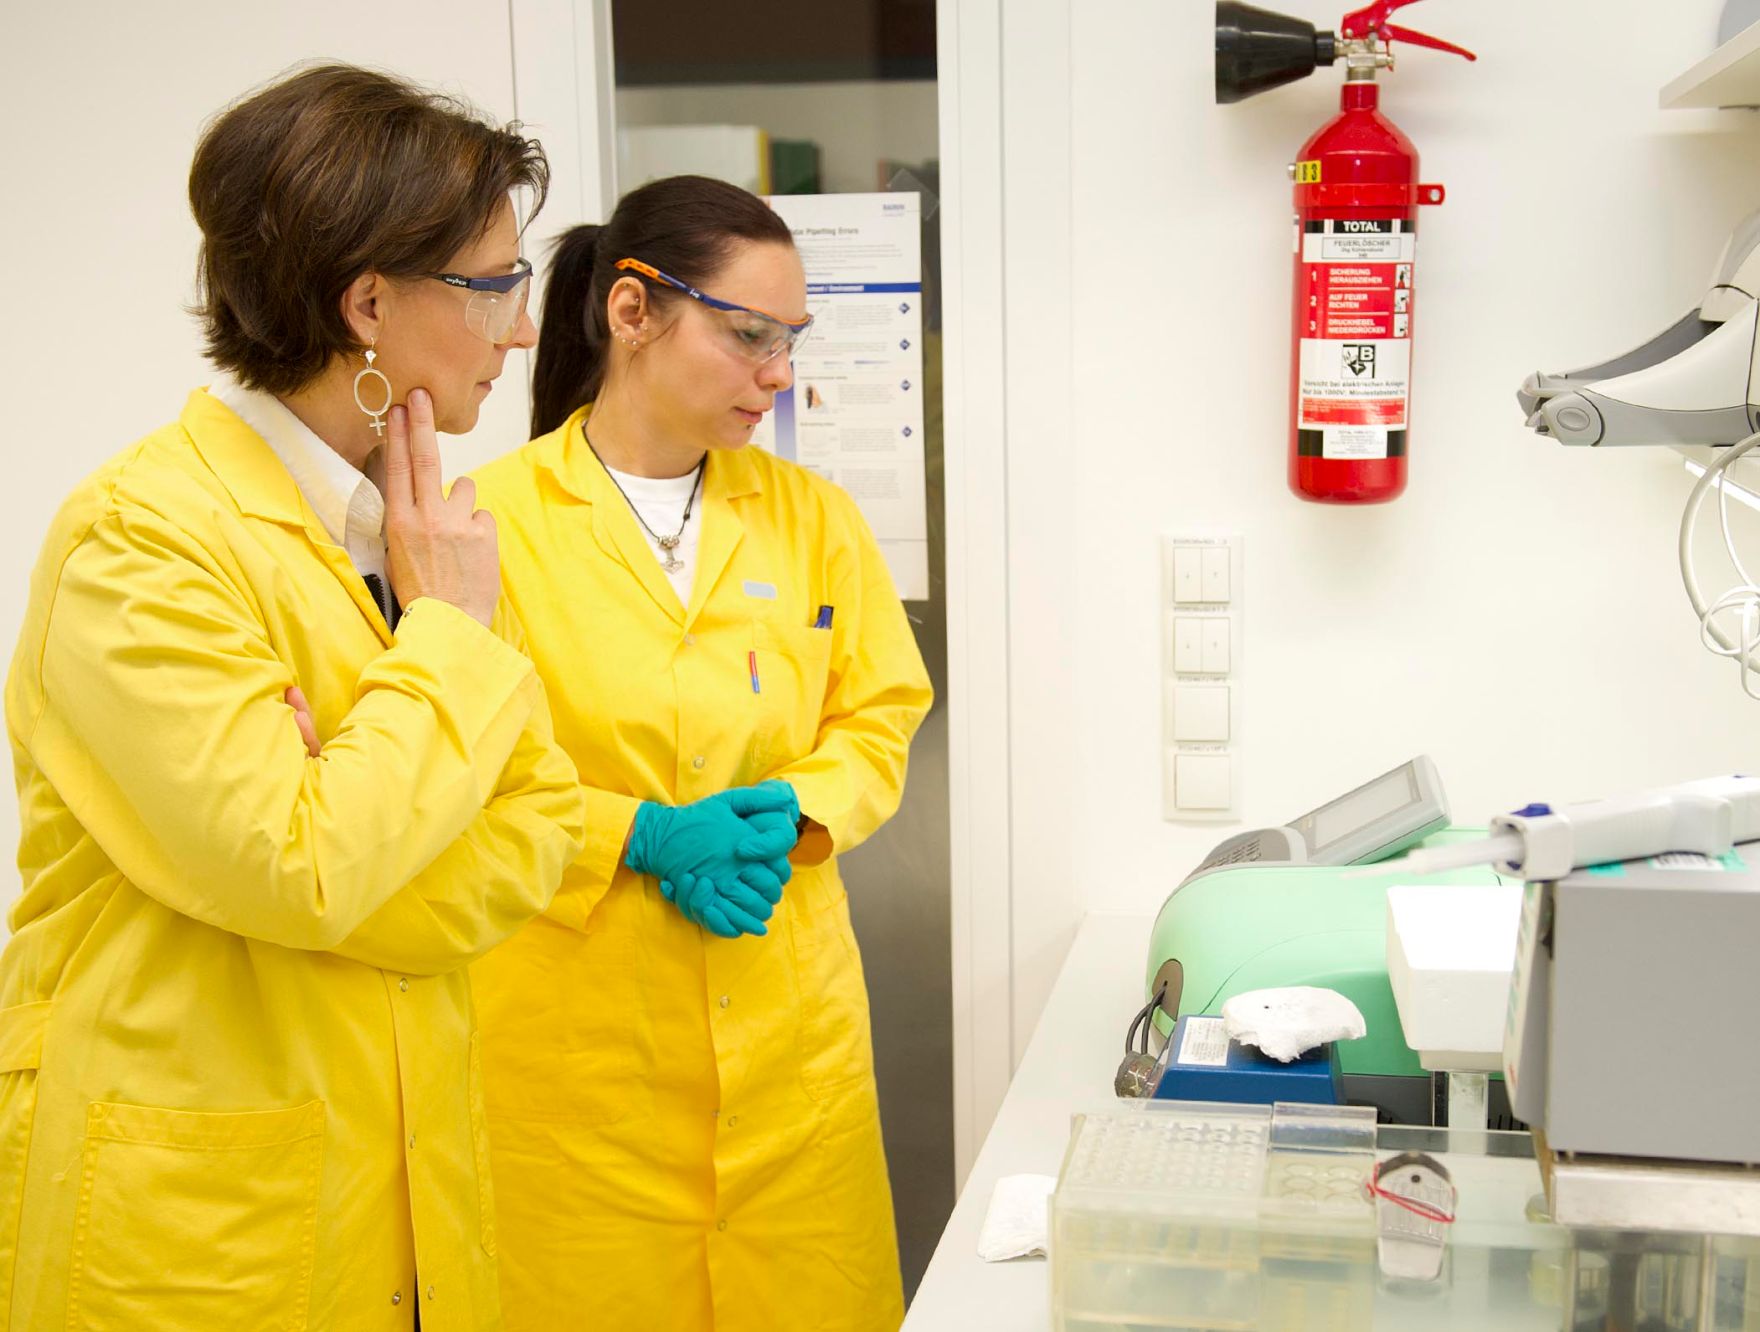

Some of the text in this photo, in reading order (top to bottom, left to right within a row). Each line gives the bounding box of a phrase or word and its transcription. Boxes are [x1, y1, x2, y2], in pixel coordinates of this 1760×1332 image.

[1343, 221, 1381, 232] TOTAL
[1334, 239, 1391, 247] FEUERLÖSCHER
[1311, 271, 1317, 281] 1
[1329, 268, 1371, 276] SICHERUNG
[1310, 296, 1317, 307] 2
[1310, 321, 1317, 331] 3
[1360, 347, 1374, 361] B
